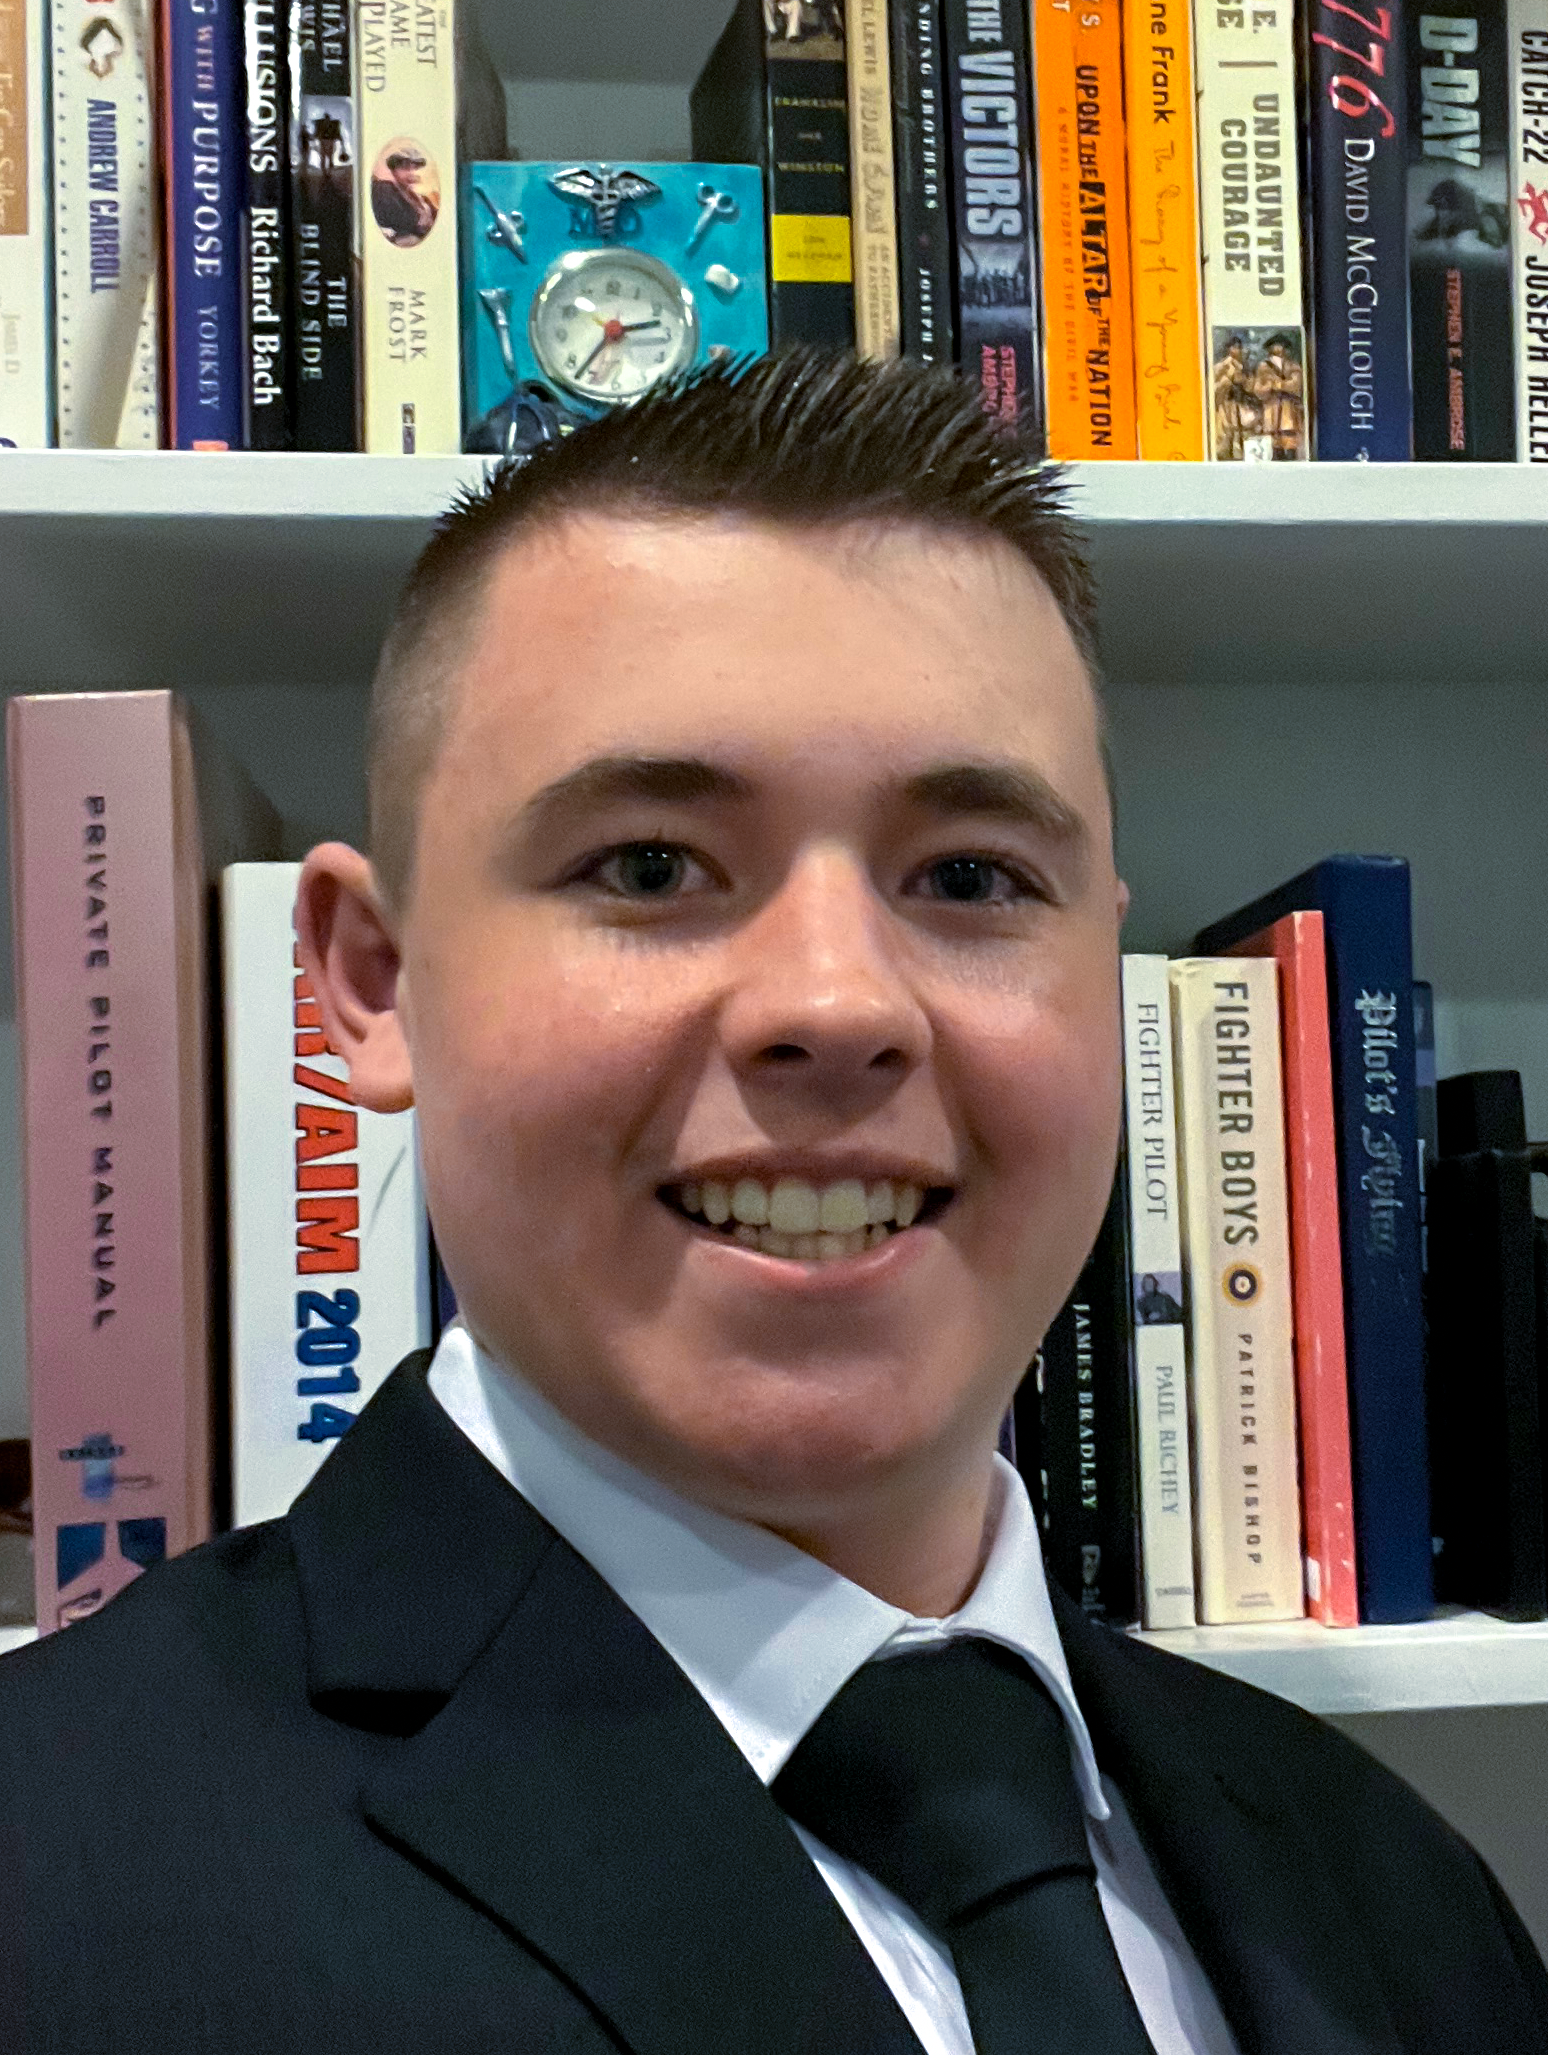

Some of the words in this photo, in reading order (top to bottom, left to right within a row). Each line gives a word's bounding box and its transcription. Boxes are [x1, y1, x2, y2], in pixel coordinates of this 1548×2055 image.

[195, 25, 215, 90] WITH
[360, 1, 386, 93] PLAYED
[965, 0, 1002, 43] THE
[247, 0, 277, 172] LLUSIONS
[1075, 63, 1100, 137] UPON
[1152, 46, 1176, 124] Frank
[1419, 15, 1481, 169] D-DAY
[87, 98, 118, 192] ANDREW
[191, 99, 223, 278] PURPOSE
[921, 88, 938, 209] BROTHERS
[958, 50, 1022, 236] VICTORS
[1078, 140, 1099, 180] THE
[1343, 137, 1374, 223] DAVID
[1078, 181, 1111, 299] ALTAR
[1219, 118, 1251, 272] COURAGE
[1253, 93, 1285, 297] UNDAUNTED
[88, 200, 120, 294] CARROLL
[250, 207, 280, 322] Richard
[300, 223, 321, 305] BLIND
[327, 277, 347, 327] THE
[388, 286, 407, 364] FROST
[410, 289, 427, 359] MARK
[919, 267, 934, 341] JOSEPH
[1096, 318, 1111, 347] THE
[1445, 269, 1463, 343] STEPHEN
[198, 305, 220, 411] YORKEY
[252, 334, 281, 405] Bach
[302, 320, 323, 380] SIDE
[1087, 348, 1112, 448] NATION
[1448, 367, 1465, 451] AMBROSE
[83, 795, 110, 969] PRIVATE
[88, 996, 113, 1118] PILOT
[1137, 1003, 1163, 1133] FIGHTER
[1213, 982, 1255, 1135] FIGHTER
[1354, 989, 1399, 1115] Pilot's
[1143, 1136, 1168, 1220] PILOT
[1220, 1151, 1260, 1247] BOYS
[90, 1147, 117, 1330] MANUAL
[296, 1288, 361, 1444] 2014
[1072, 1303, 1092, 1380] JAMES
[1156, 1366, 1176, 1423] PAUL
[1237, 1332, 1258, 1447] PATRICK
[1078, 1392, 1098, 1510] BRADLEY
[1159, 1430, 1179, 1515] RICHEY
[1242, 1465, 1262, 1565] BISHOP
